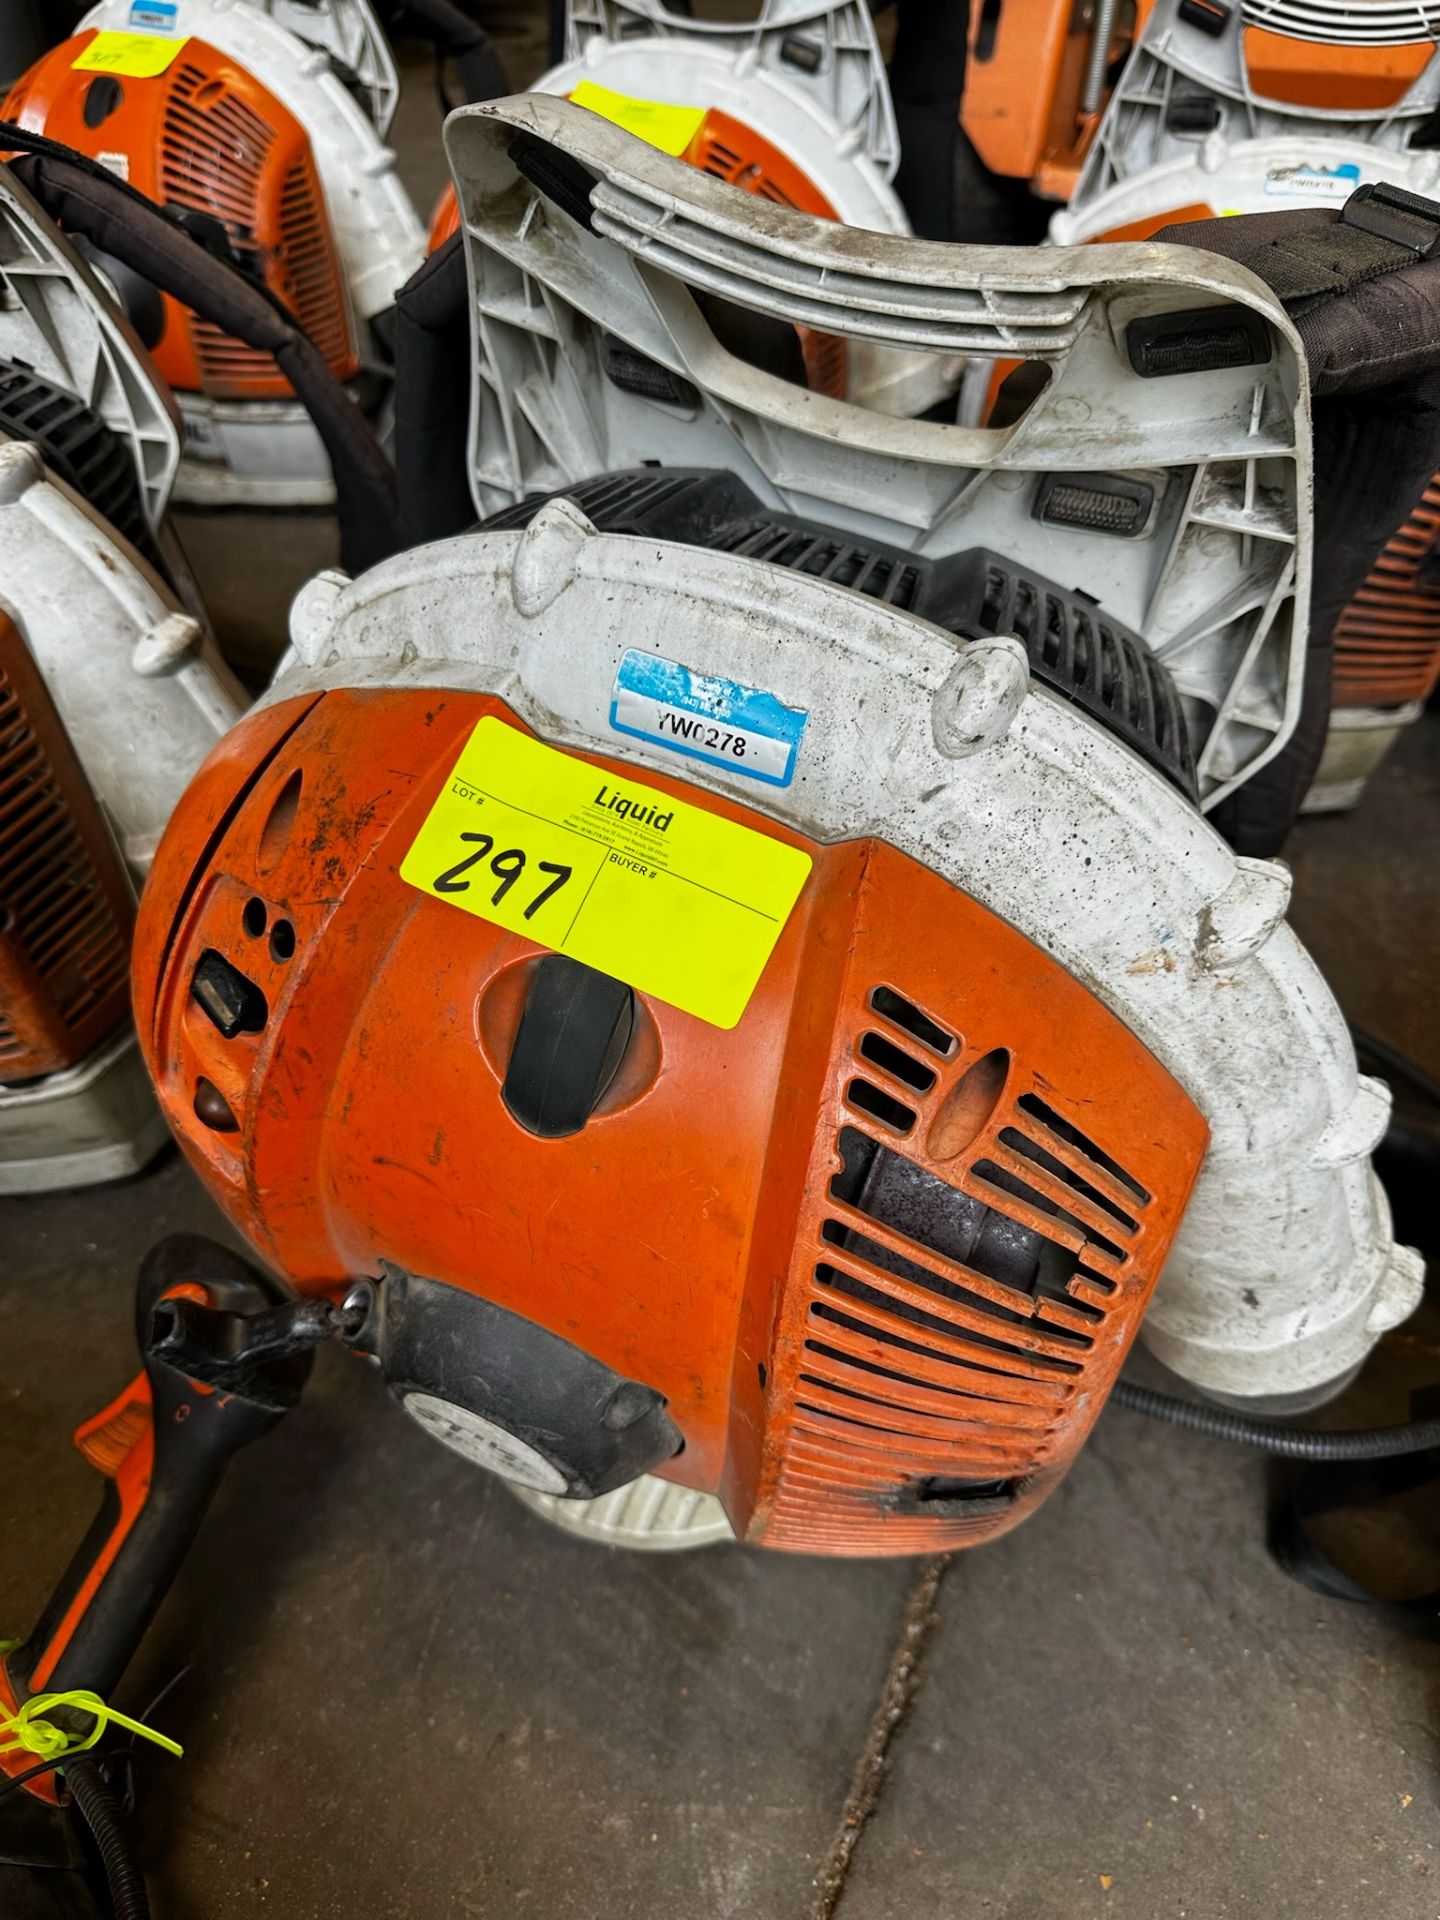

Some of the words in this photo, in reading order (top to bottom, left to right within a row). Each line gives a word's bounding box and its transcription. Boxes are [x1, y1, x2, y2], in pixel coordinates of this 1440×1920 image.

[656, 706, 747, 757] YW0278
[451, 783, 476, 801] LOT
[476, 797, 486, 806] #
[593, 785, 675, 833] Liquid
[433, 832, 573, 920] 297
[609, 853, 648, 876] BUYER
[649, 871, 657, 879] #
